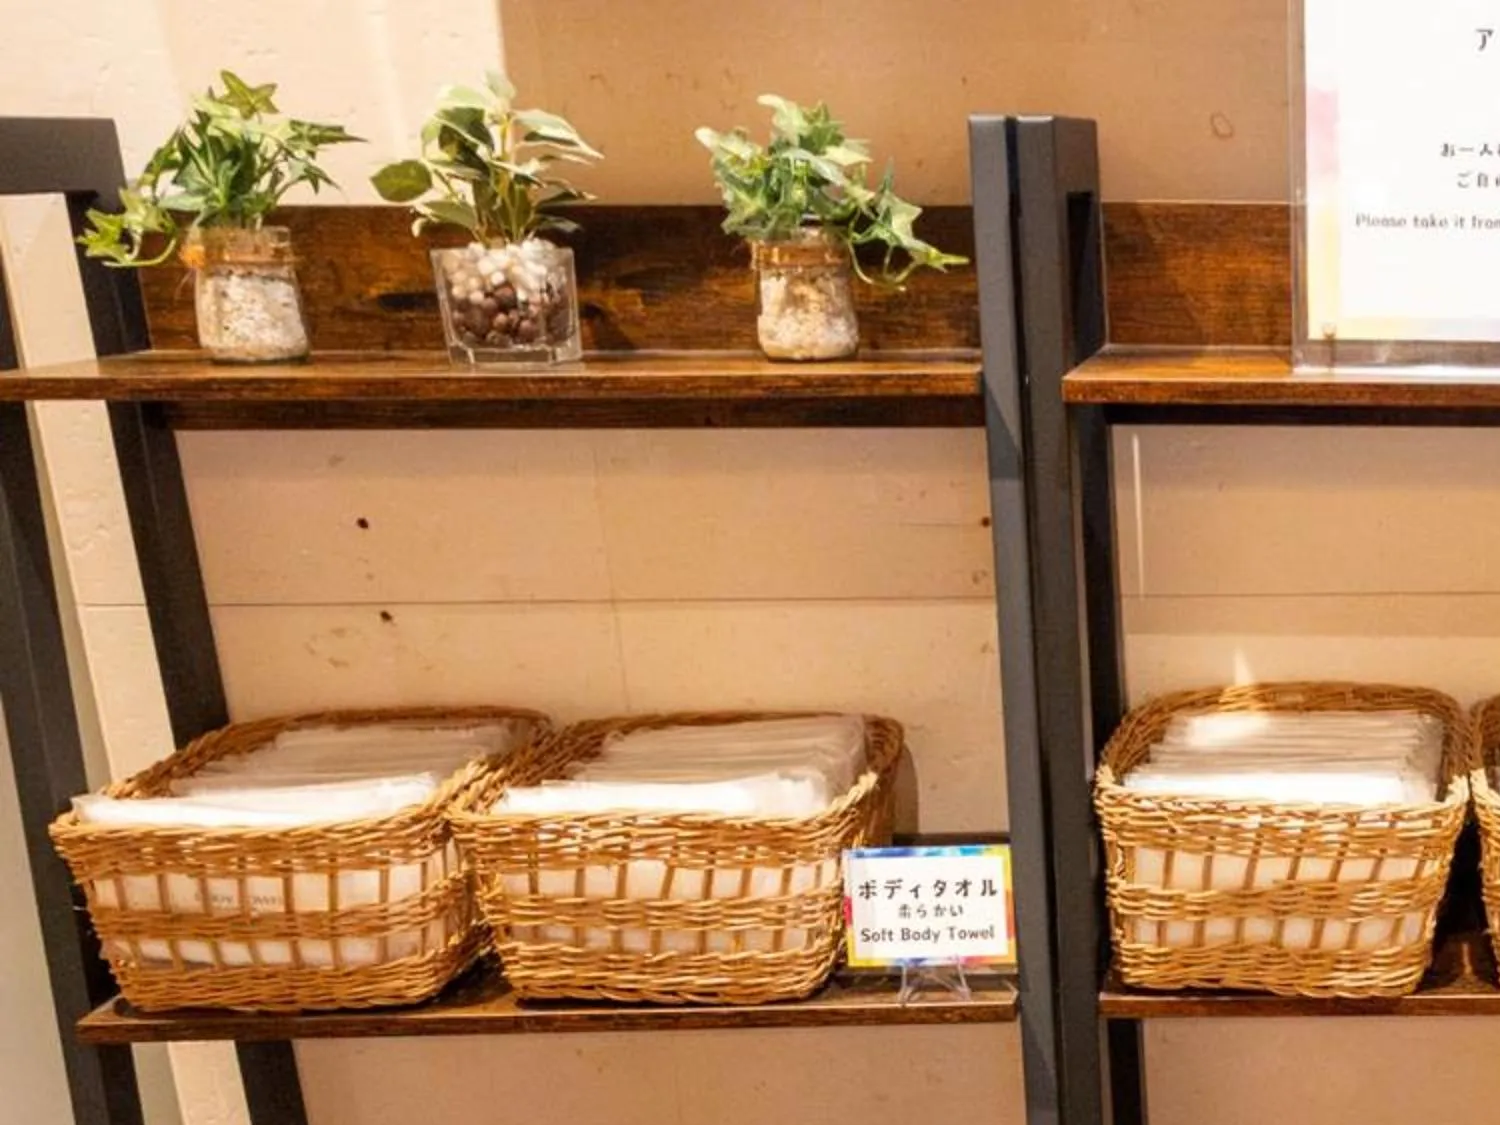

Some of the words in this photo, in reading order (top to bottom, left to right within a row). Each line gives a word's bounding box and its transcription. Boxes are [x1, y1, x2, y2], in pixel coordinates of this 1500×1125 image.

[1355, 213, 1407, 229] Please
[1413, 213, 1448, 229] take
[1454, 213, 1465, 229] it
[858, 879, 998, 899] ボディタオル
[861, 928, 894, 942] Soft
[901, 927, 941, 943] Body
[948, 925, 995, 941] Towel
